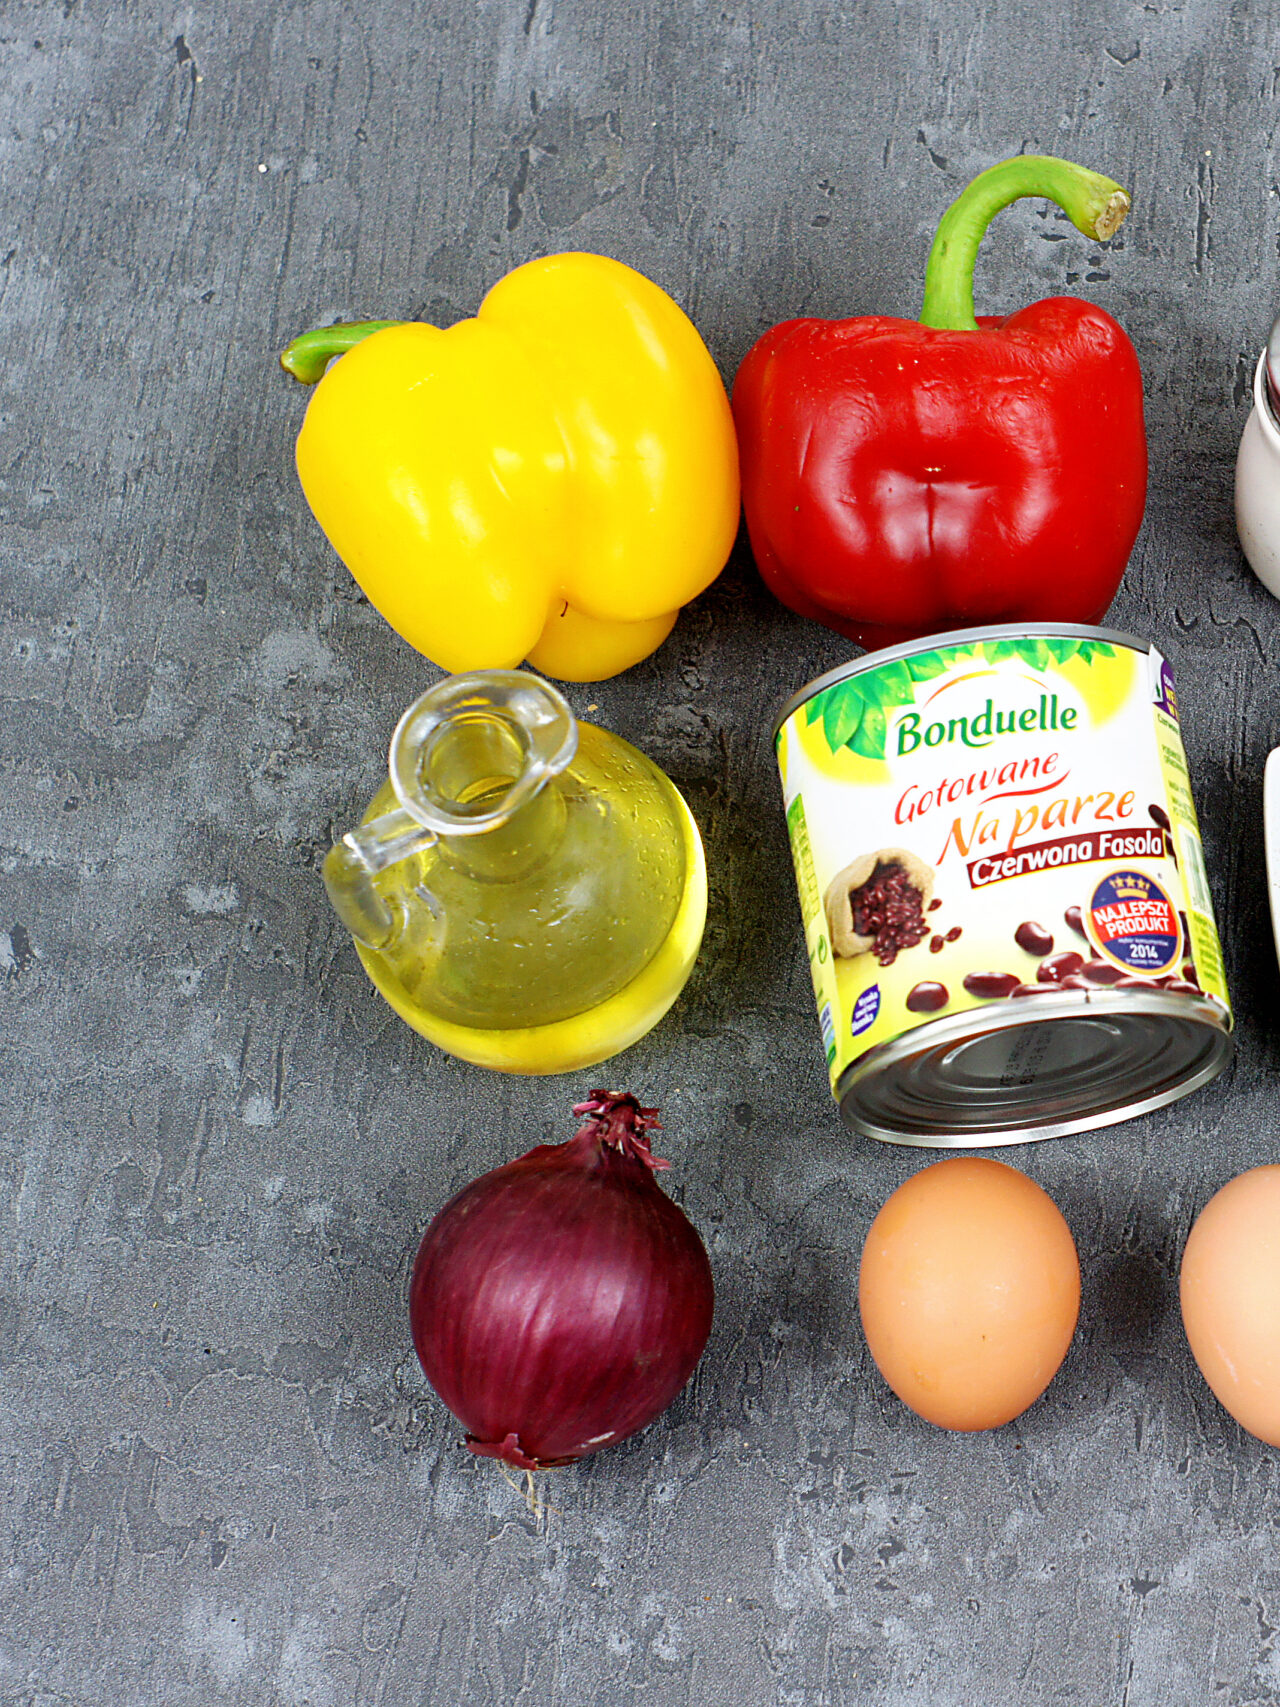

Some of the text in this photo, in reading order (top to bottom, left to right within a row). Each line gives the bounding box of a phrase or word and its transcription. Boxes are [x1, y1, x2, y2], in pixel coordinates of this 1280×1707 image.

[895, 693, 1078, 757] Bonduelle
[894, 752, 1059, 825] Gotowane
[936, 810, 1000, 866] Na
[1005, 790, 1136, 857] parze
[971, 831, 1163, 886] Czerwona Fasola
[1093, 901, 1168, 926] NAJLEPSZY
[1105, 917, 1169, 938] PRODUKT
[1129, 943, 1159, 959] 2014
